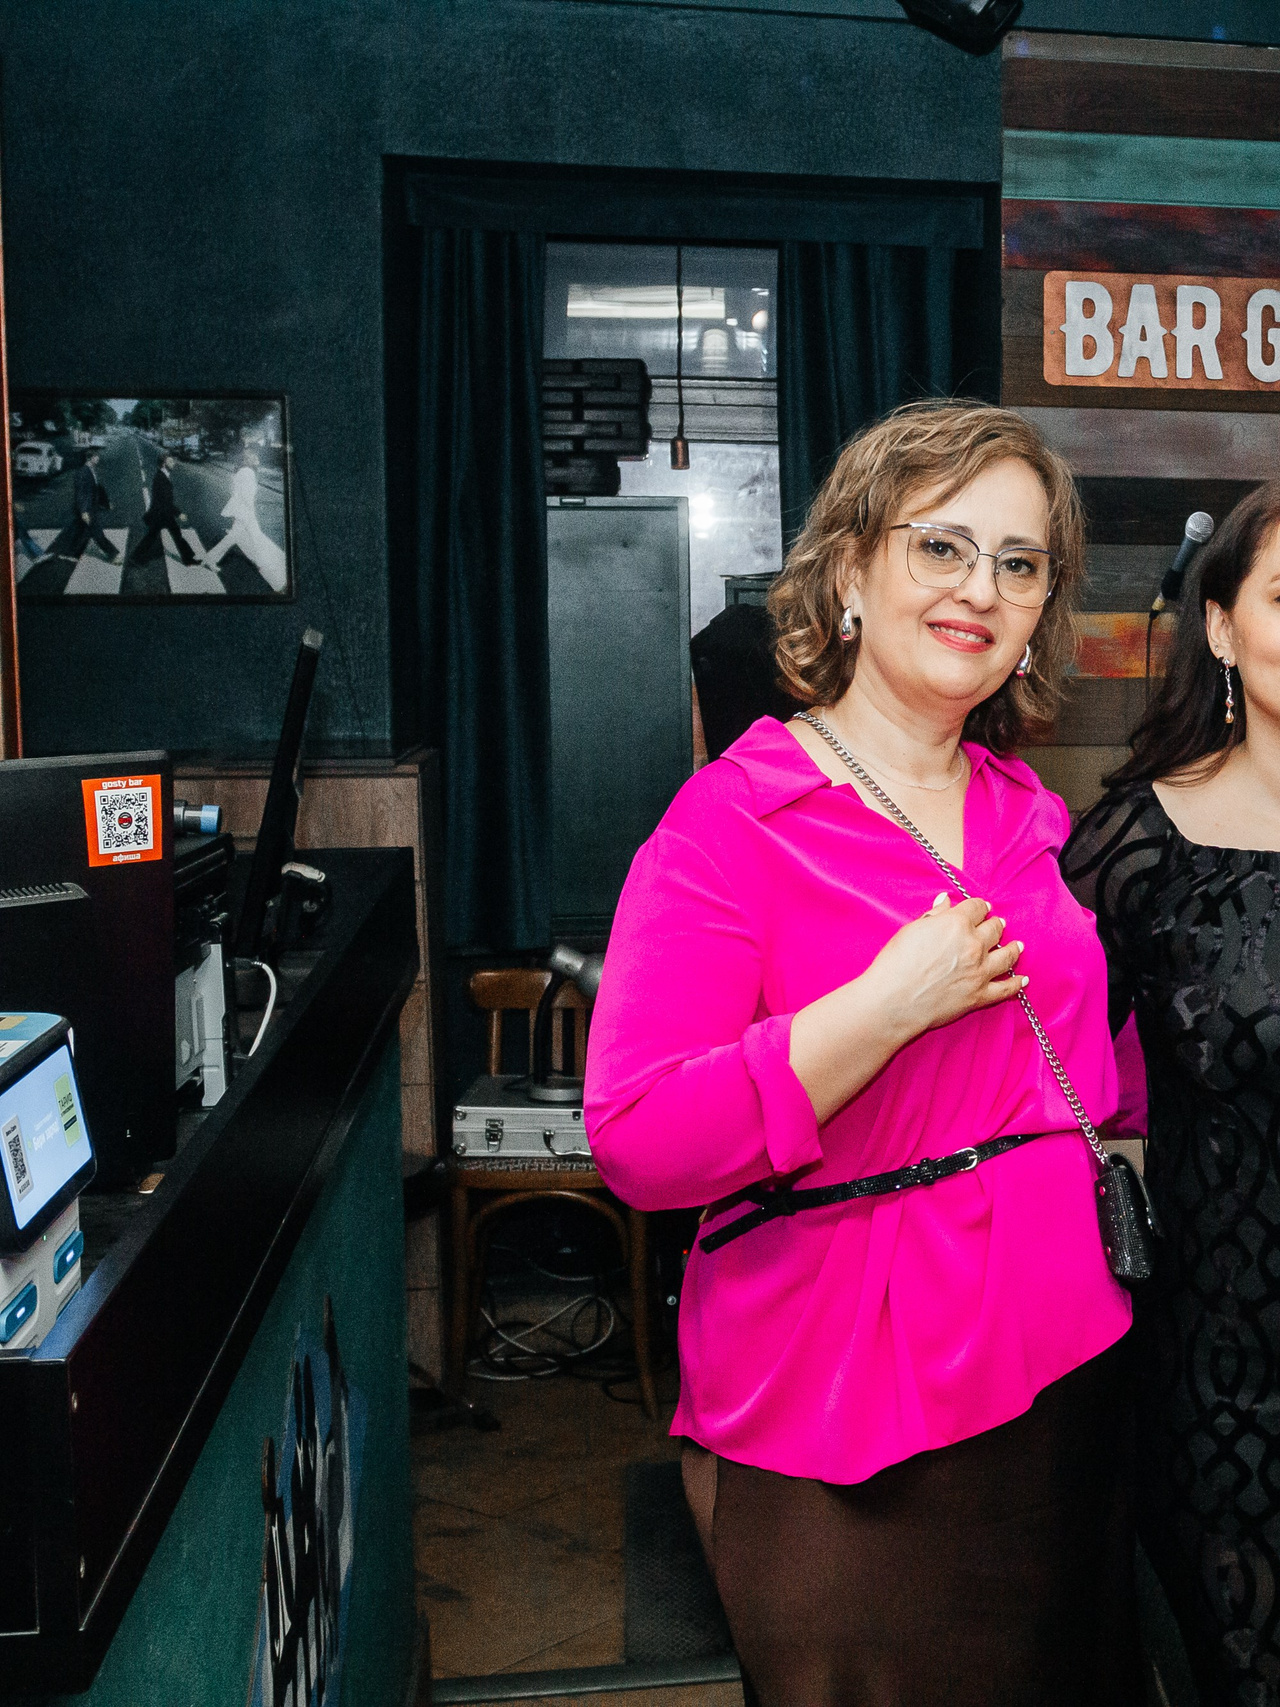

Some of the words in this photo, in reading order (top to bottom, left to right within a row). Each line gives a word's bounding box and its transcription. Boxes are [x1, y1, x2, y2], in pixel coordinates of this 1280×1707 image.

[1059, 281, 1223, 380] BAR
[102, 780, 126, 789] gosty
[128, 778, 143, 786] bar
